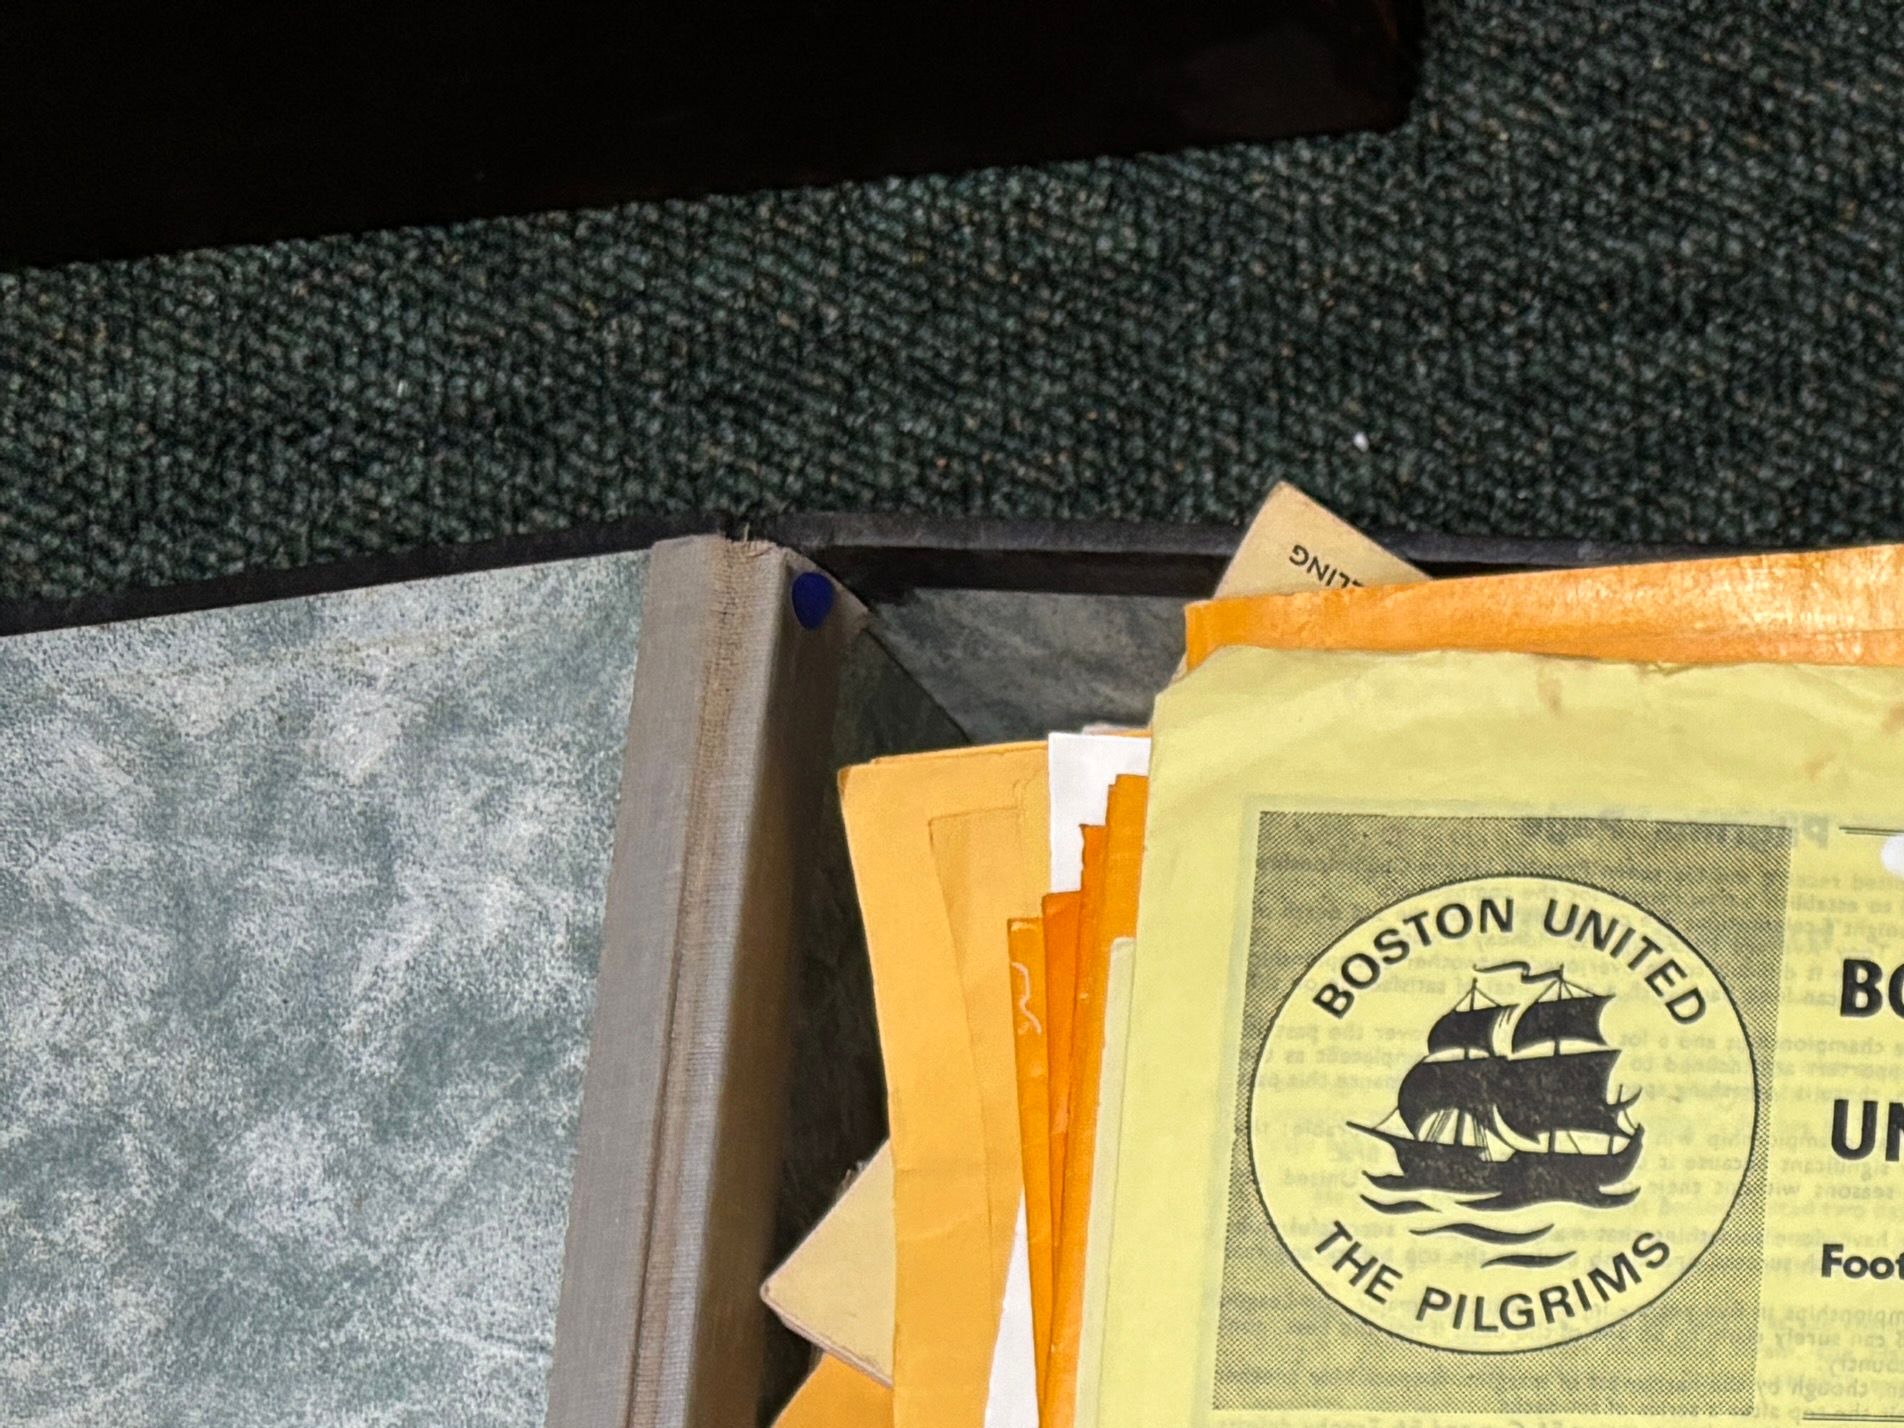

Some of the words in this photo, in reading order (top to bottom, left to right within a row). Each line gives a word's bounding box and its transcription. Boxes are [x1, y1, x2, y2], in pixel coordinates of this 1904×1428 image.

[1288, 543, 1364, 588] LING
[1313, 898, 1517, 1021] BOSTON
[1540, 898, 1713, 1030] UNITED
[1312, 1225, 1402, 1312] THE
[1415, 1231, 1677, 1337] PILGRIMS
